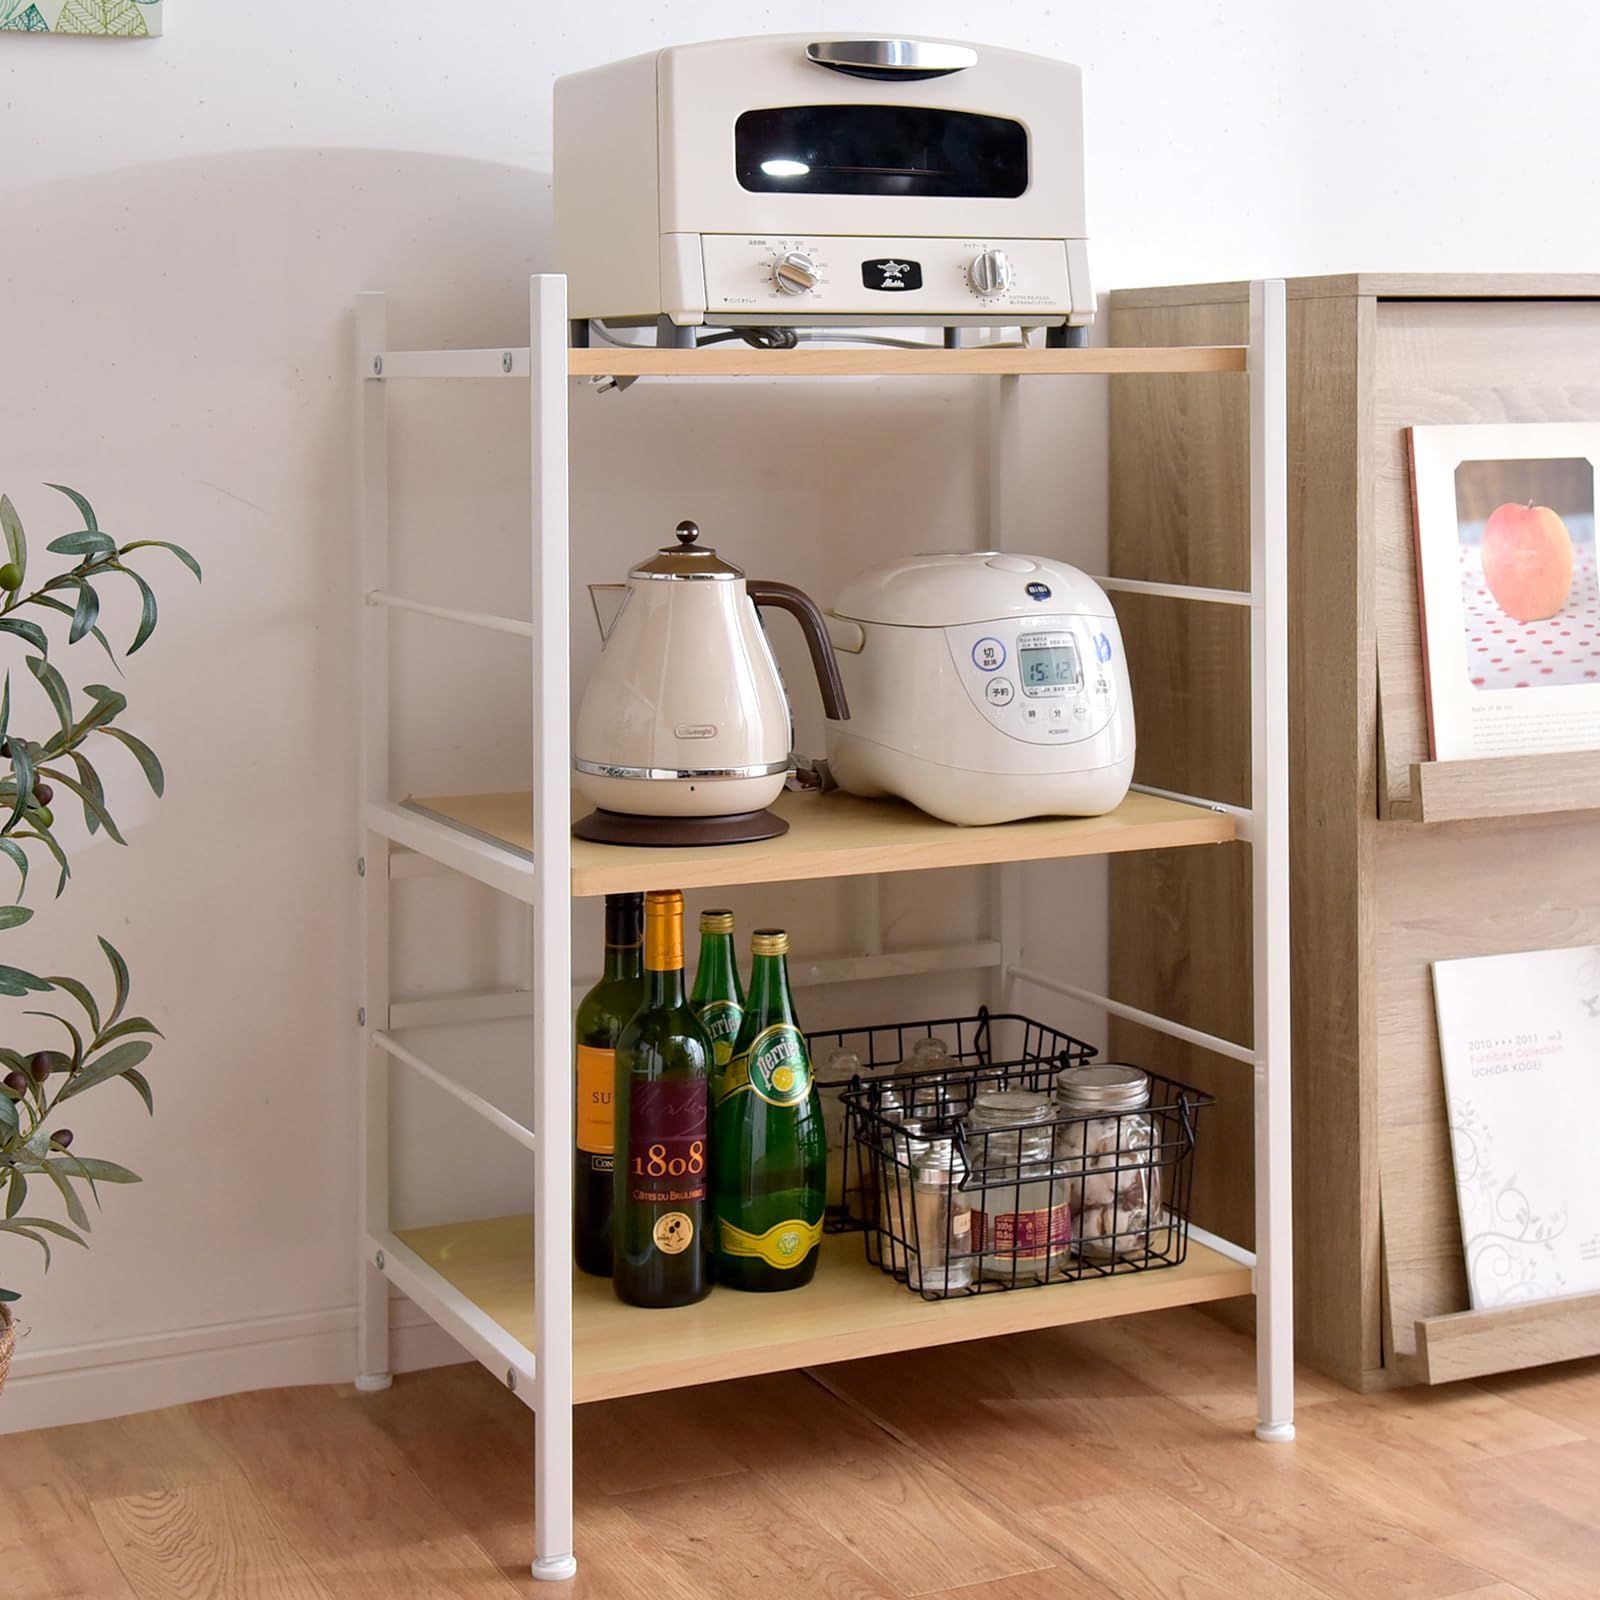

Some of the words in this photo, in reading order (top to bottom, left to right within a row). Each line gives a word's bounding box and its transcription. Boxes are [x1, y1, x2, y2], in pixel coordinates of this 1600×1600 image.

[983, 647, 995, 659] 切
[1471, 1065, 1509, 1078] UCHIDA
[631, 1140, 704, 1177] 1808
